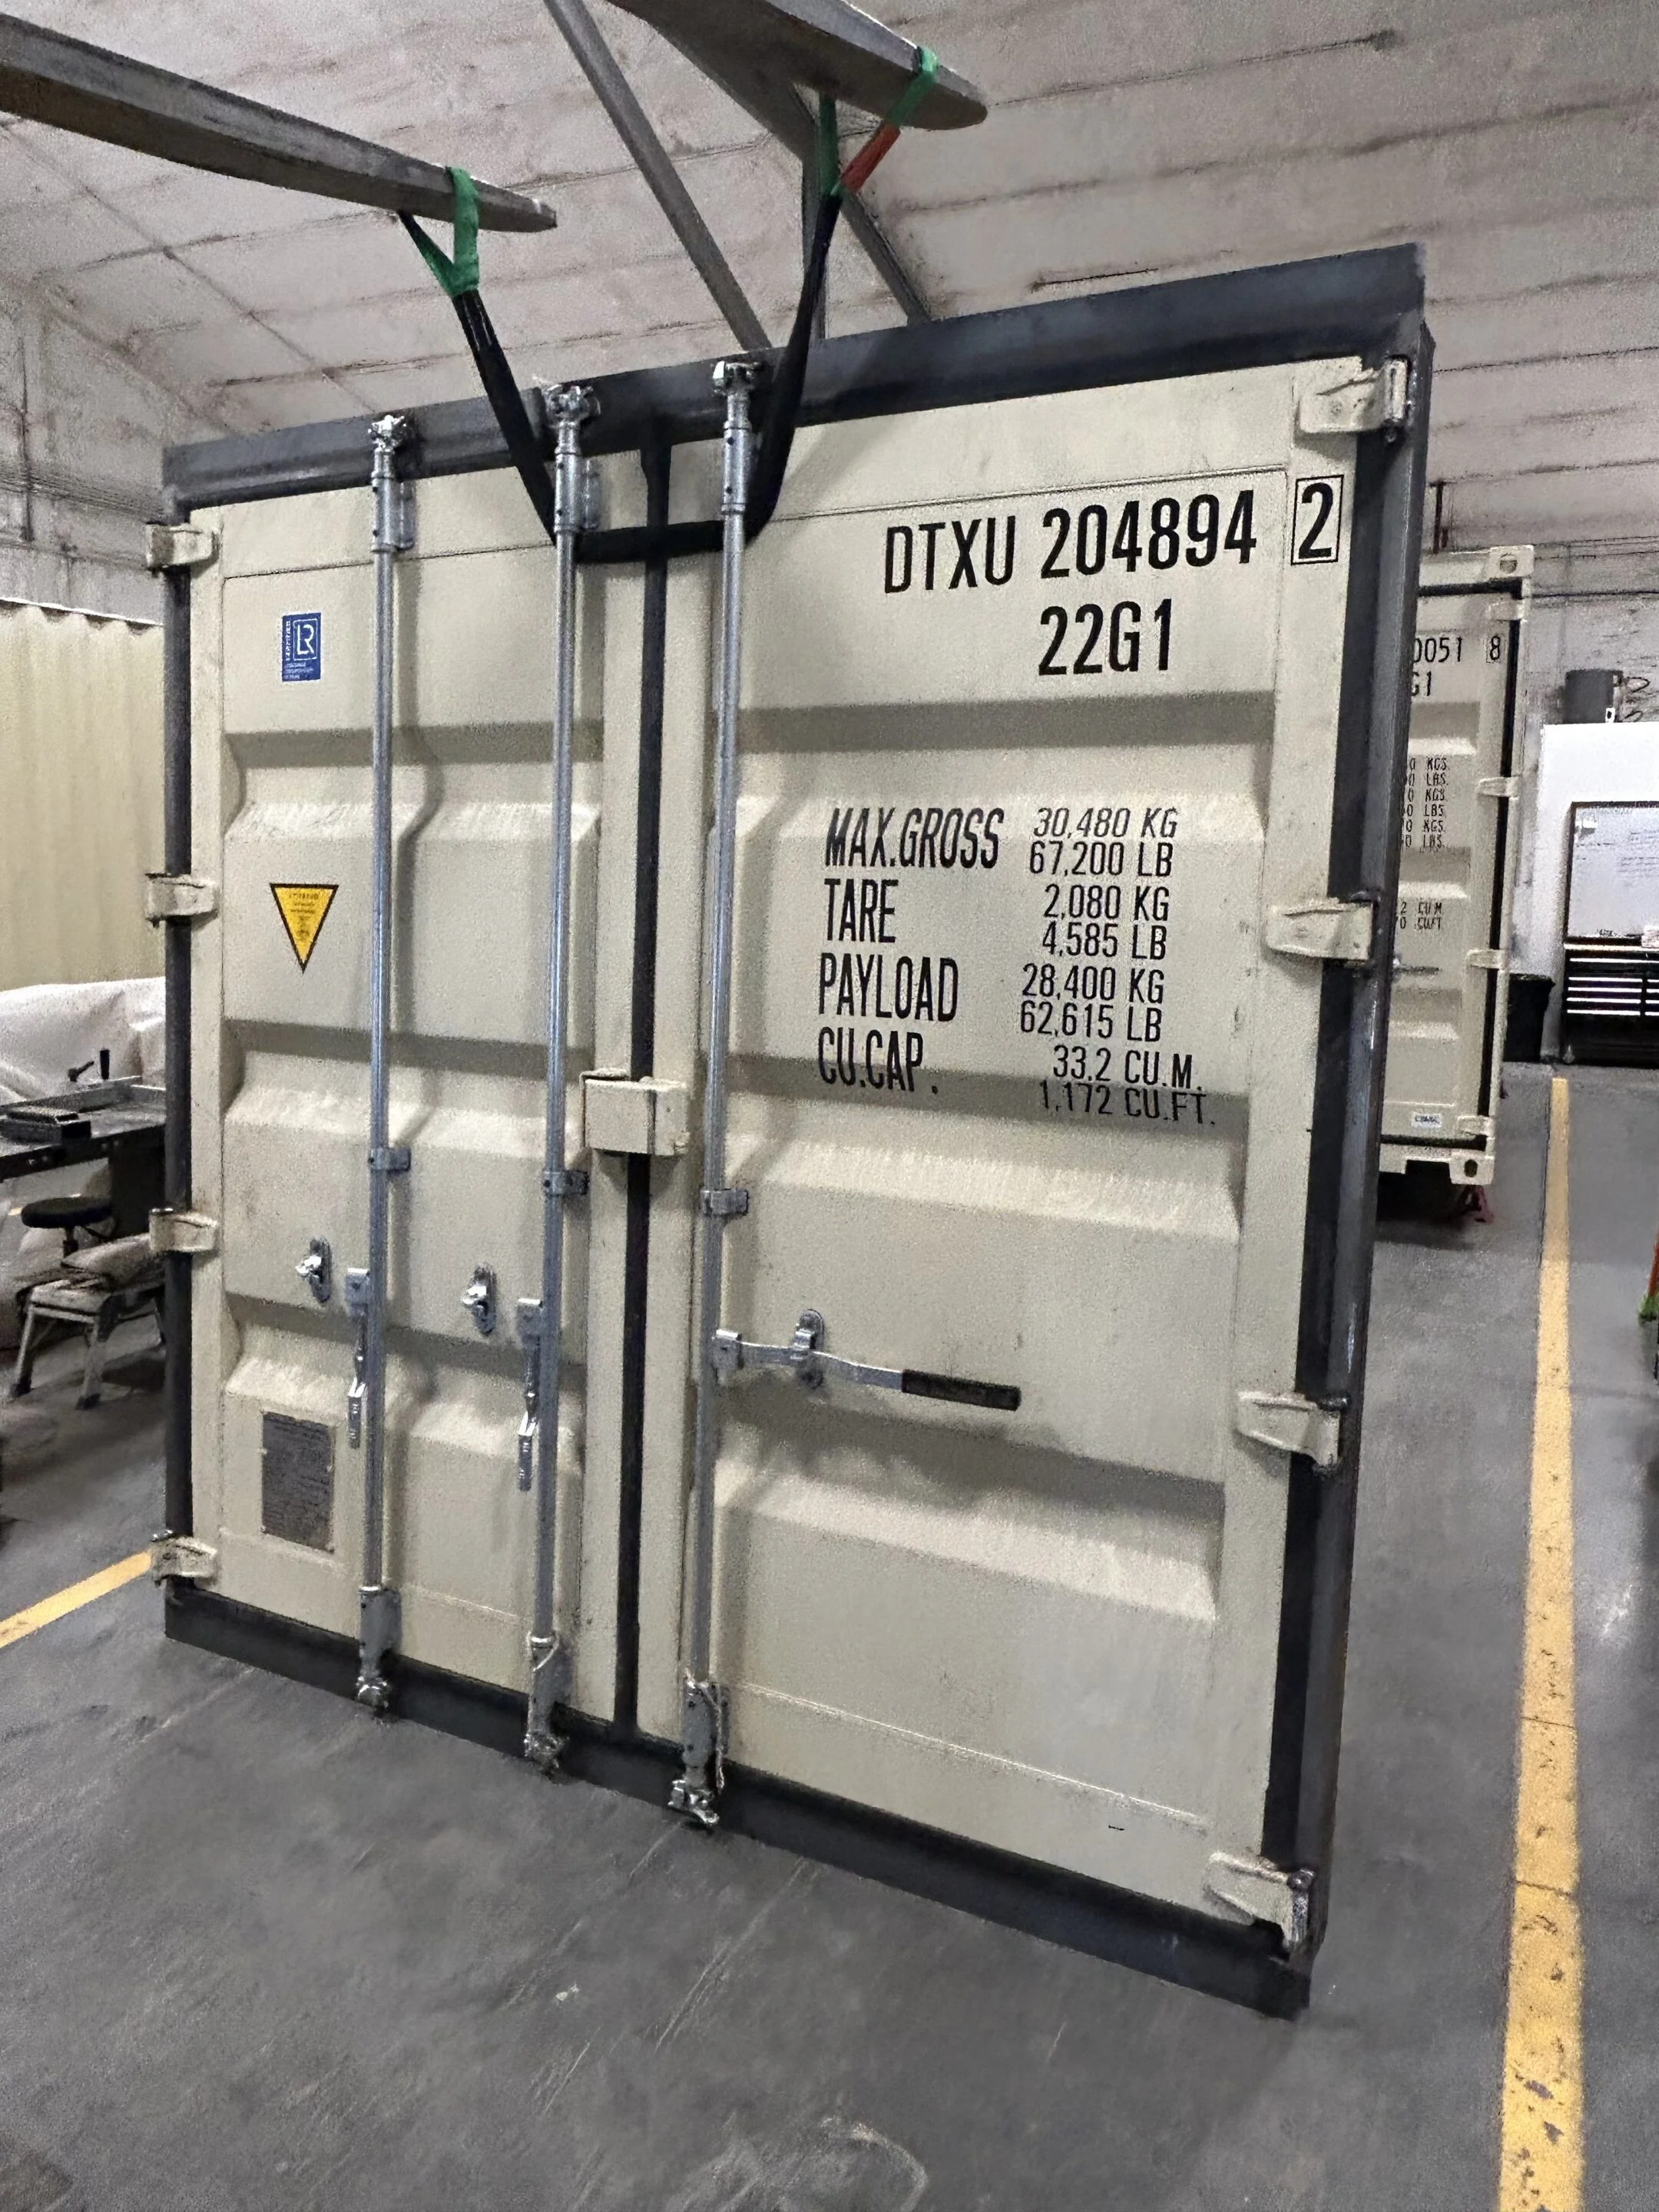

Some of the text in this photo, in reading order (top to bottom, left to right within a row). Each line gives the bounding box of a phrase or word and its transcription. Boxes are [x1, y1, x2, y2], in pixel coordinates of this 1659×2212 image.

[884, 482, 1336, 593] DTXU 204894 2
[1038, 598, 1172, 677] 22G1
[1489, 635, 1501, 661] 8
[824, 806, 1177, 869] MAX.GROSS 30,480 KG
[1029, 841, 1173, 878] 67,200 LB
[823, 879, 1170, 943] TARE 2,080 KG
[1042, 922, 1167, 960] 4,585 LB
[819, 952, 1164, 1022] PAYLOAD 28,400 KG
[1020, 1002, 1162, 1042] 62,615 LB
[1053, 1045, 1111, 1082] 33.2
[1124, 1087, 1216, 1126] CU.FT.
